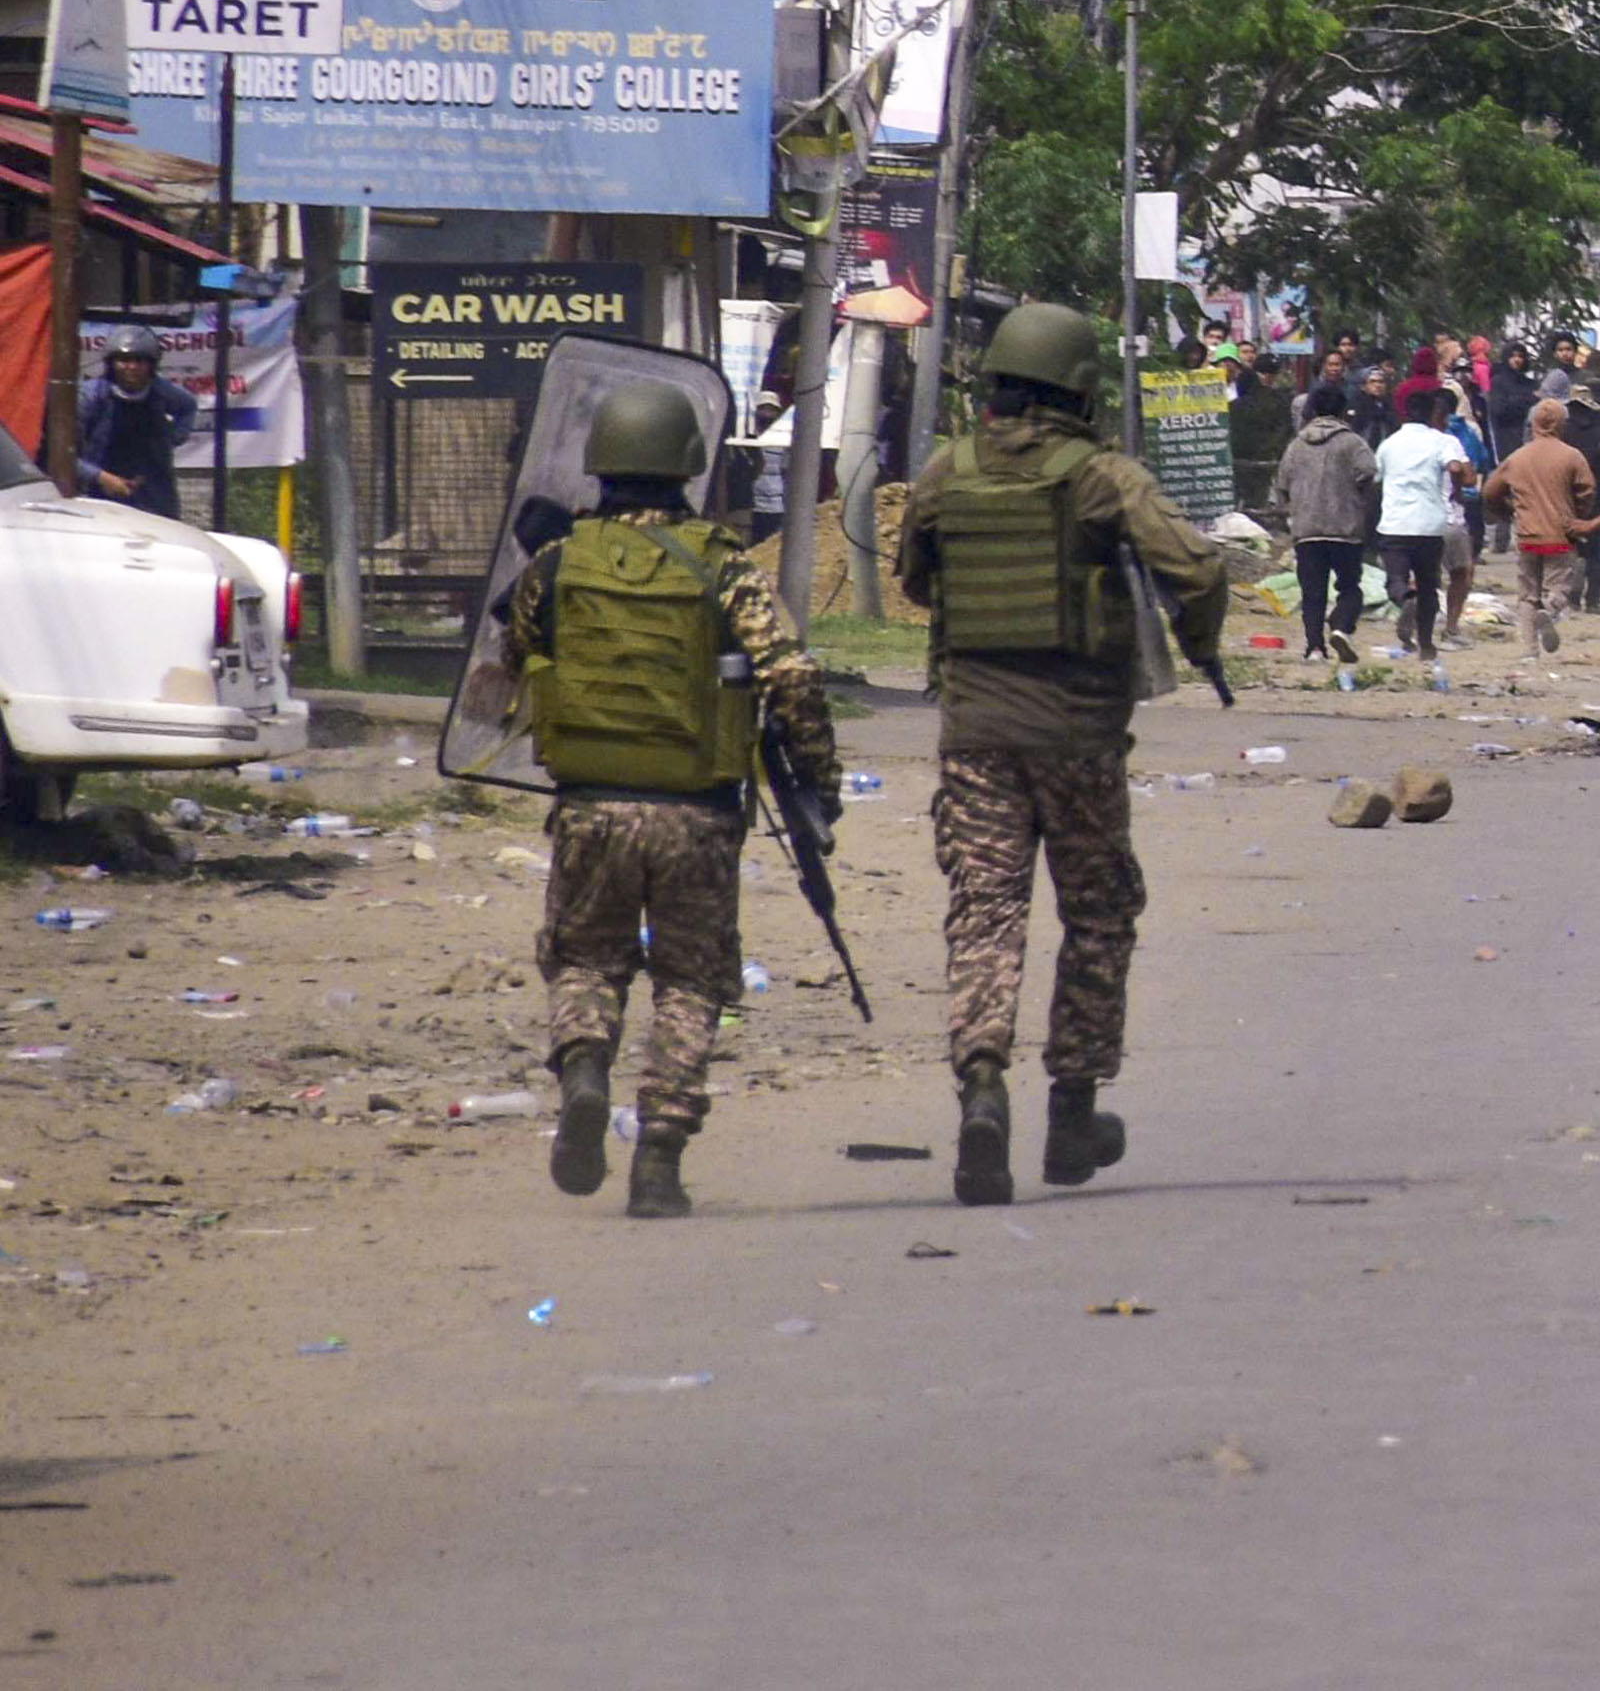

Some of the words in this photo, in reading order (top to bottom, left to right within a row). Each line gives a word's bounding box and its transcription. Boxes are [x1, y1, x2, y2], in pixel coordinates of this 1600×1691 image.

[129, 52, 206, 98] SHREE
[219, 55, 298, 101] HREE
[312, 57, 497, 107] GOURGOBIND
[615, 65, 741, 113] COLLEGE
[391, 294, 483, 323] CAR
[490, 293, 625, 323] WASH
[398, 342, 485, 359] DETAILING
[1158, 412, 1220, 430] XEROX
